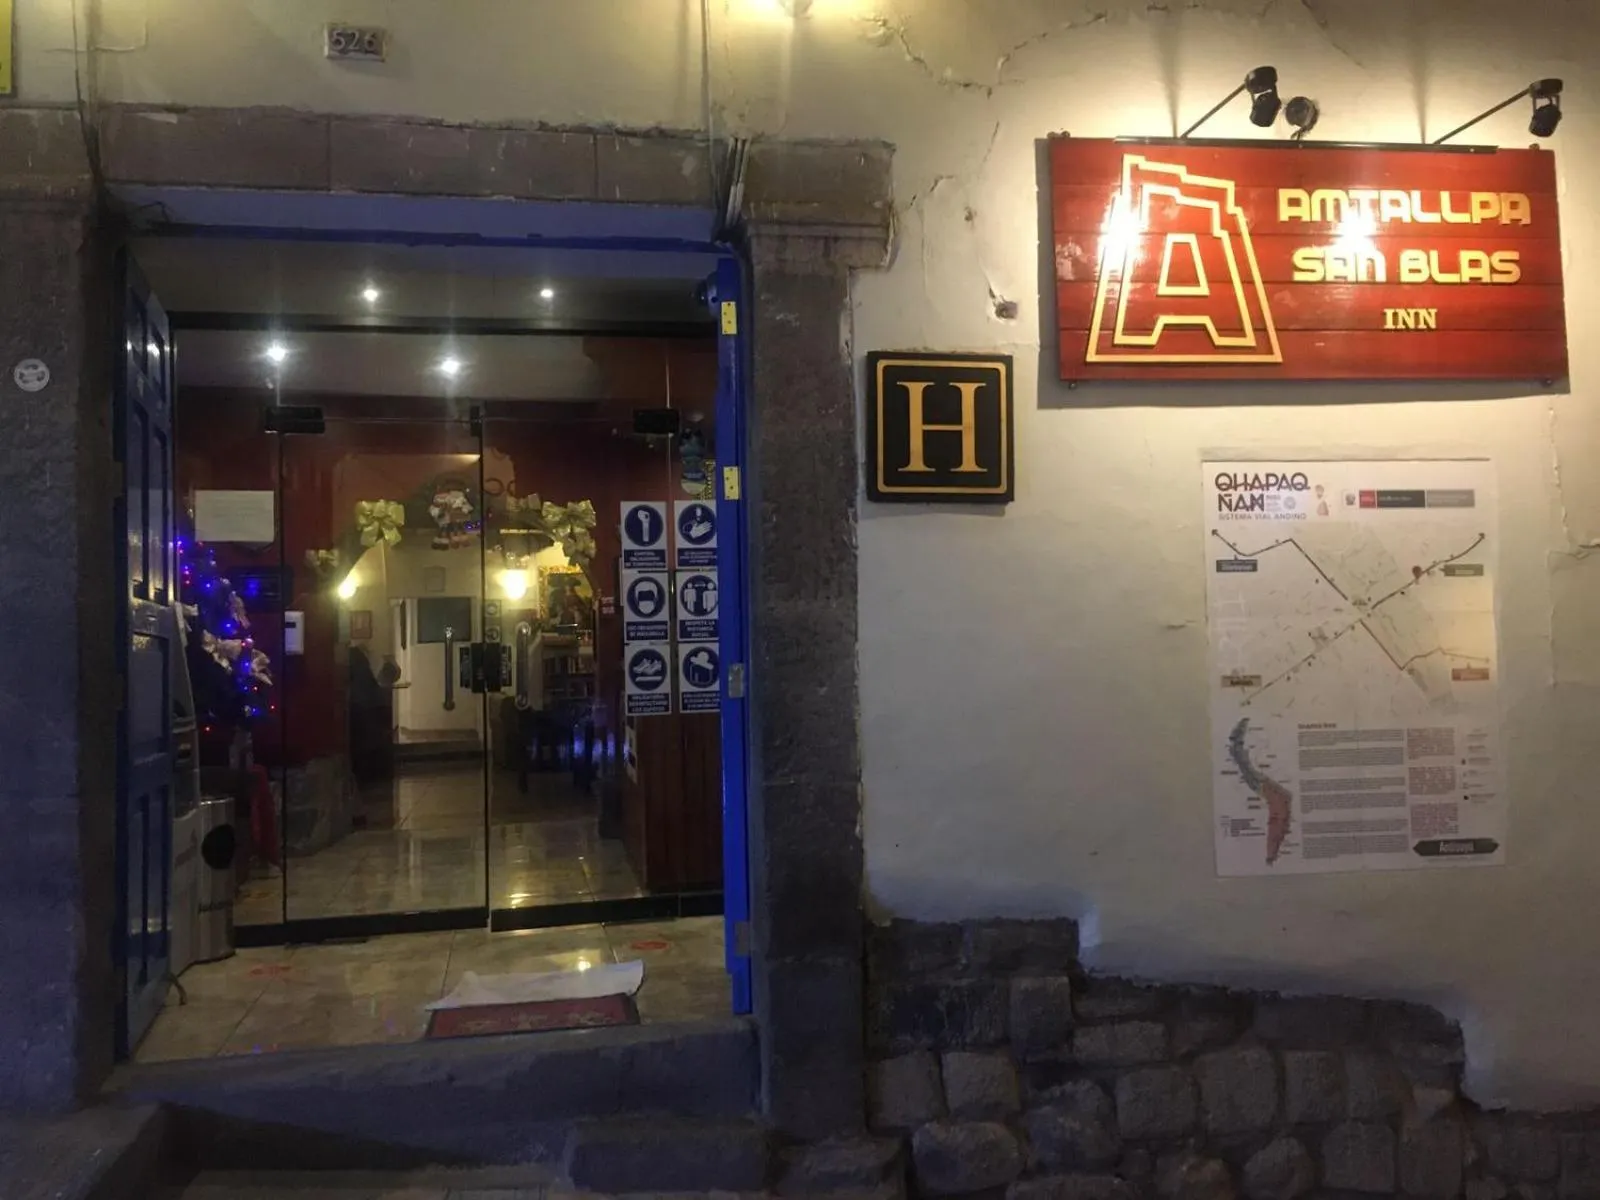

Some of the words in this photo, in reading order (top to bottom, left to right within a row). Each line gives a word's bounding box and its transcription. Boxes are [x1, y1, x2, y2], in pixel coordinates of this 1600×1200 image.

[332, 29, 377, 52] 526
[1277, 187, 1532, 226] AMTALLPA
[1291, 248, 1387, 284] SAN
[1399, 249, 1522, 285] BLAS
[1383, 307, 1438, 331] INN
[896, 381, 988, 473] H
[1214, 472, 1311, 492] QHAPAQ
[1218, 513, 1252, 521] SISTEMA
